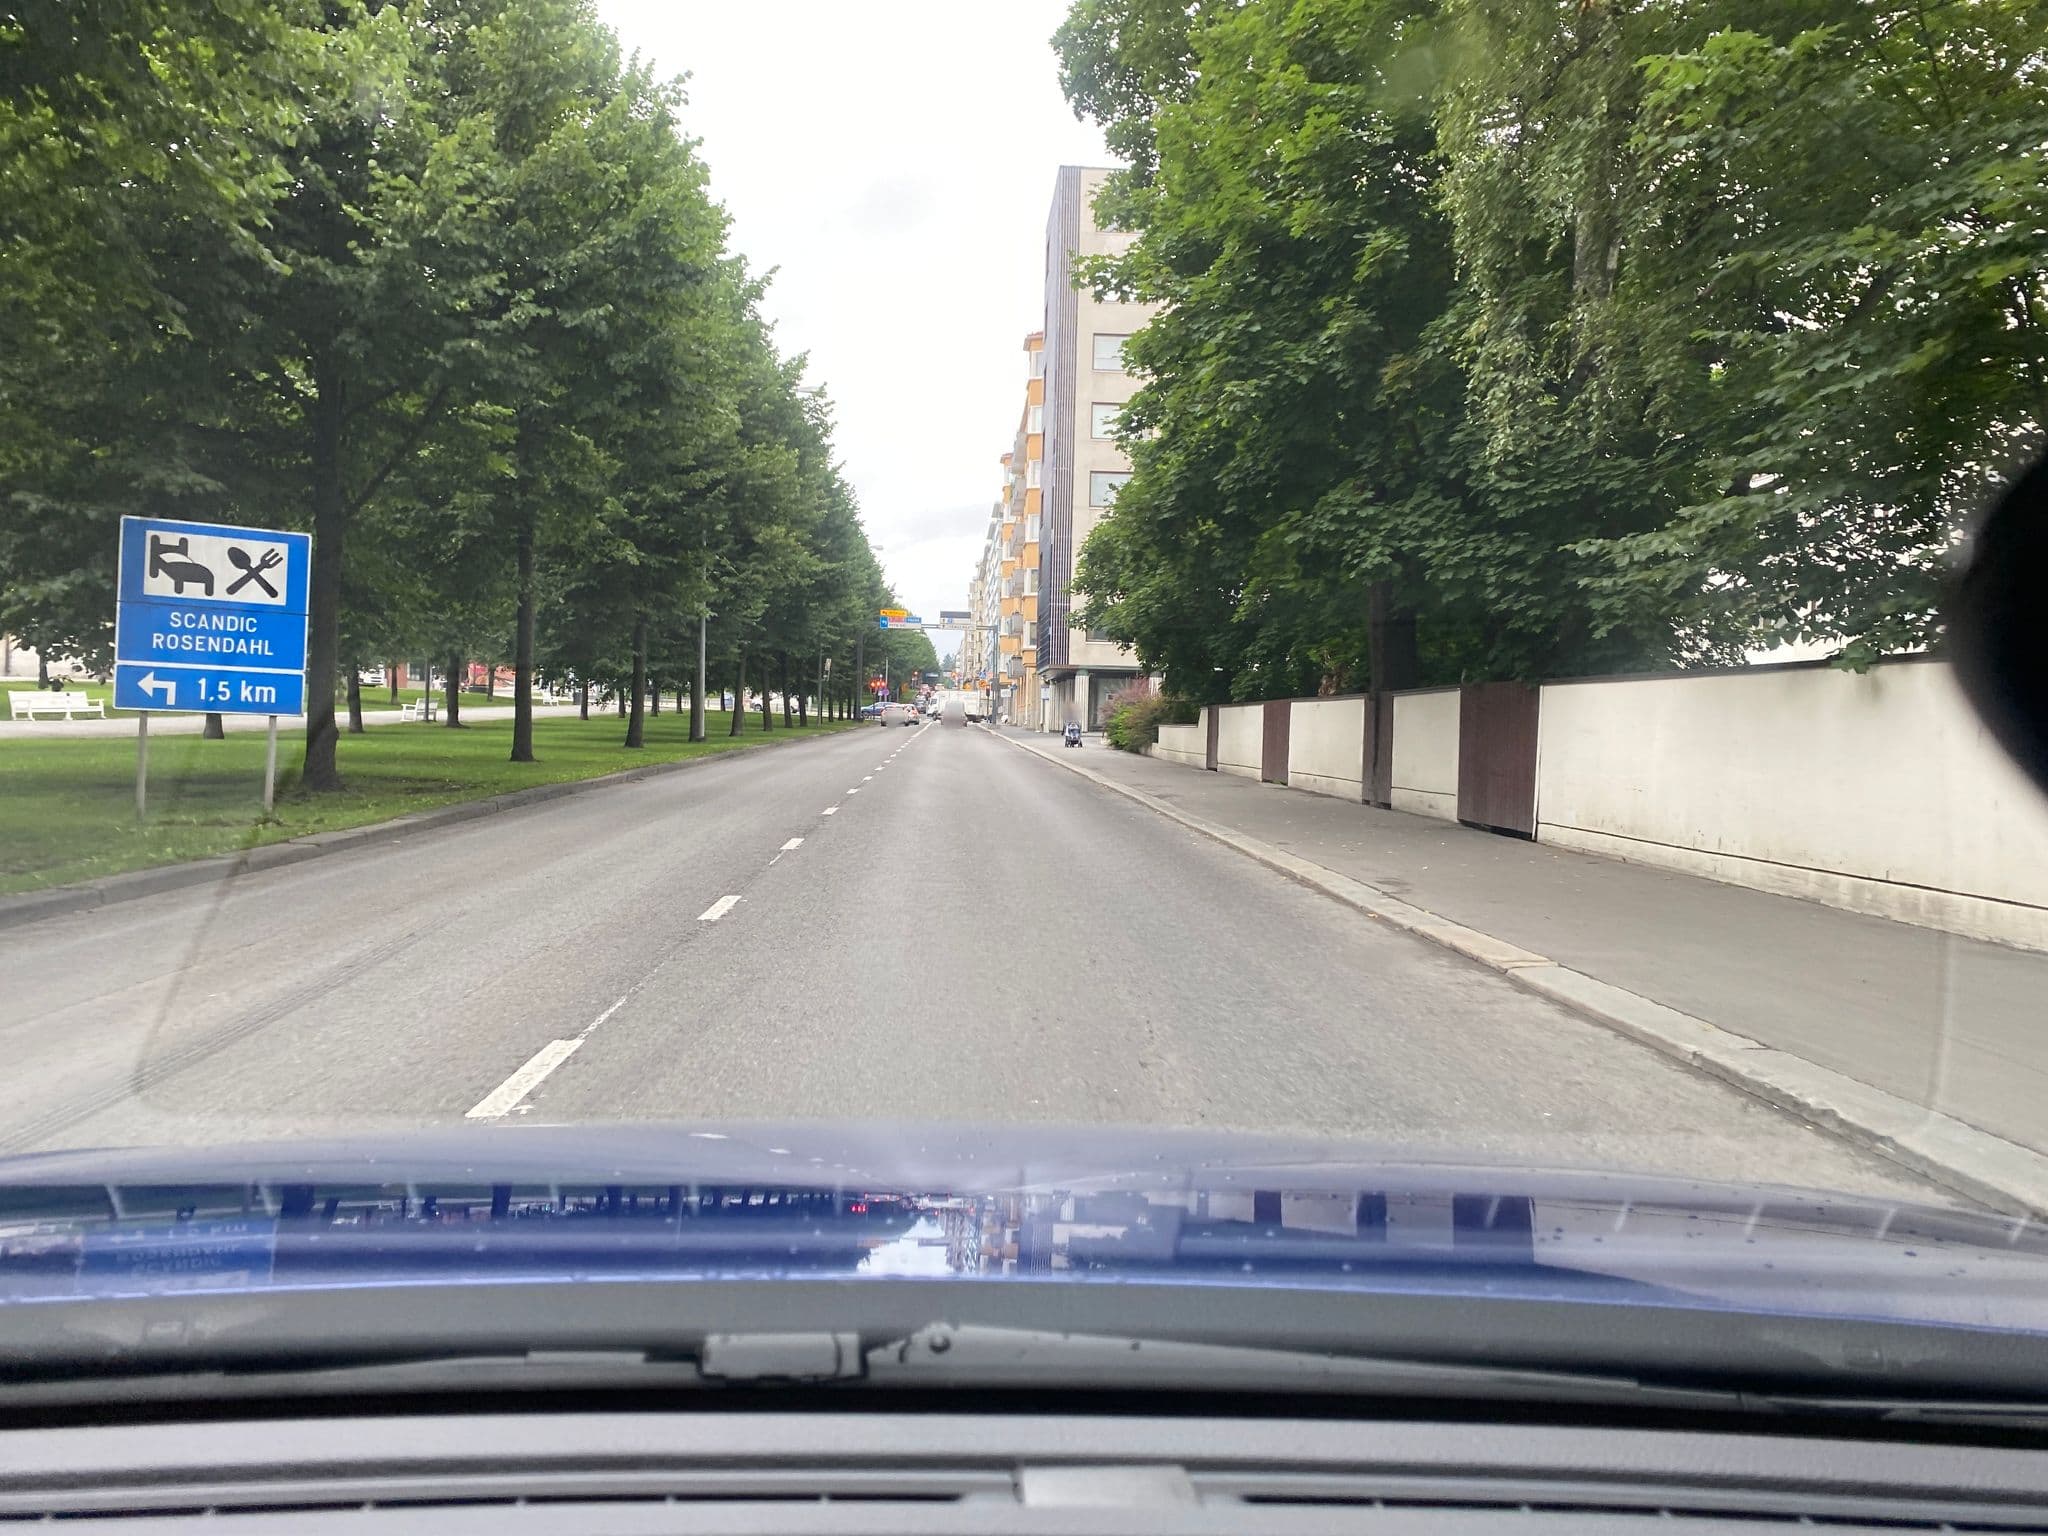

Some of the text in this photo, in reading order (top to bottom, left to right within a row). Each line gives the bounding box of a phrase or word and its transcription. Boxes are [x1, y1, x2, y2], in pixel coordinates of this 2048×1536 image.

[169, 612, 258, 633] SCANDIC
[152, 633, 274, 656] ROSENDAHL
[240, 680, 276, 704] km
